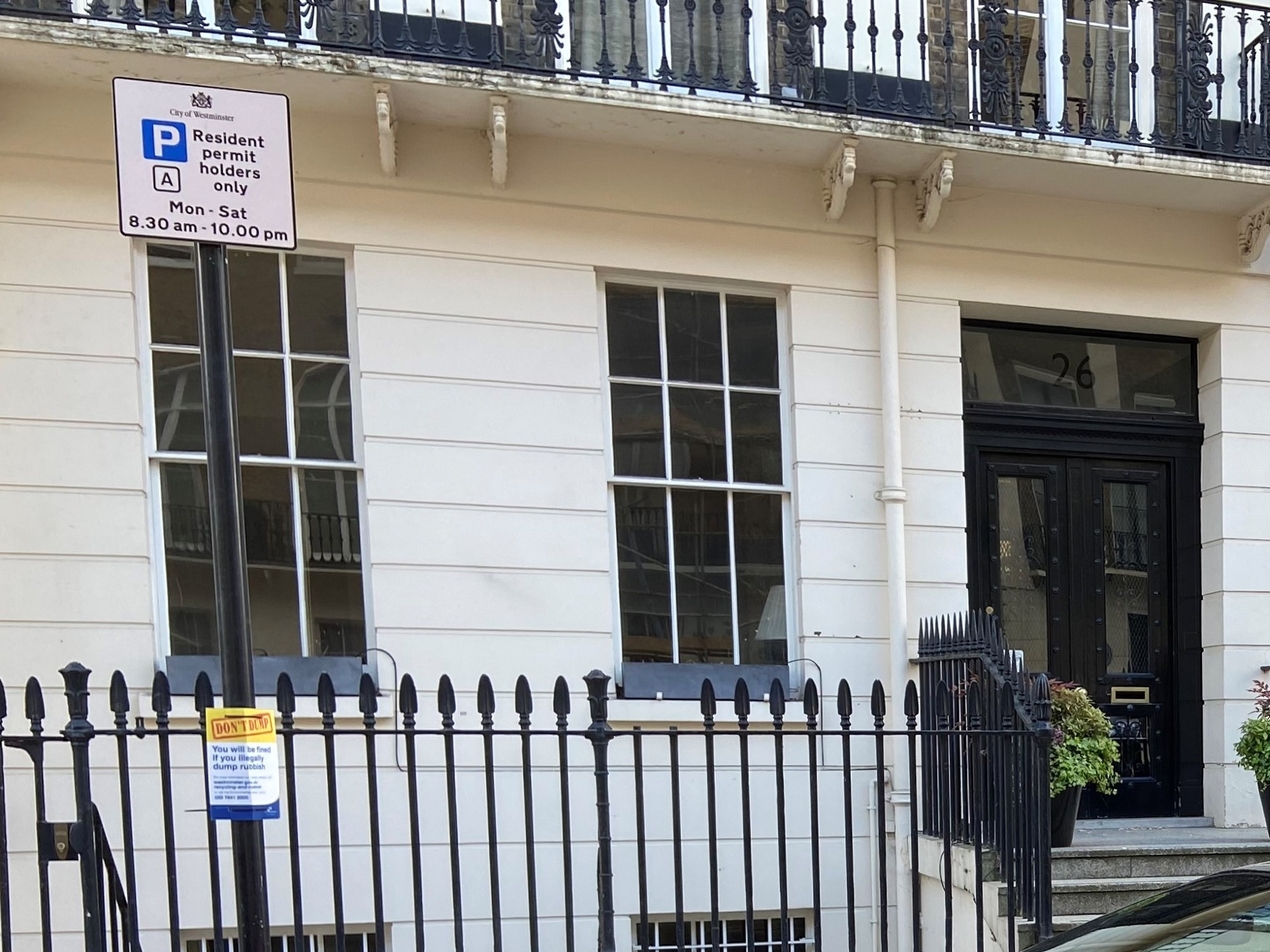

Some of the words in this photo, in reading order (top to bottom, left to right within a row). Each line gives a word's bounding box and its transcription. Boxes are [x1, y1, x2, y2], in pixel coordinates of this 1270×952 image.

[170, 109, 183, 118] City
[194, 110, 234, 122] Westminster
[152, 124, 180, 157] P
[193, 130, 264, 148] Resident
[203, 149, 256, 163] permit
[161, 172, 174, 186] A
[200, 162, 260, 179] holders
[214, 181, 248, 196] only
[170, 201, 204, 216] Mon
[219, 205, 247, 219] Sat
[129, 215, 168, 230] 8.30
[174, 222, 197, 232] am
[211, 223, 259, 238] 10.00
[264, 229, 288, 241] pm
[1052, 353, 1095, 389] 26
[216, 720, 246, 734] DON'T
[249, 717, 269, 731] DUMP
